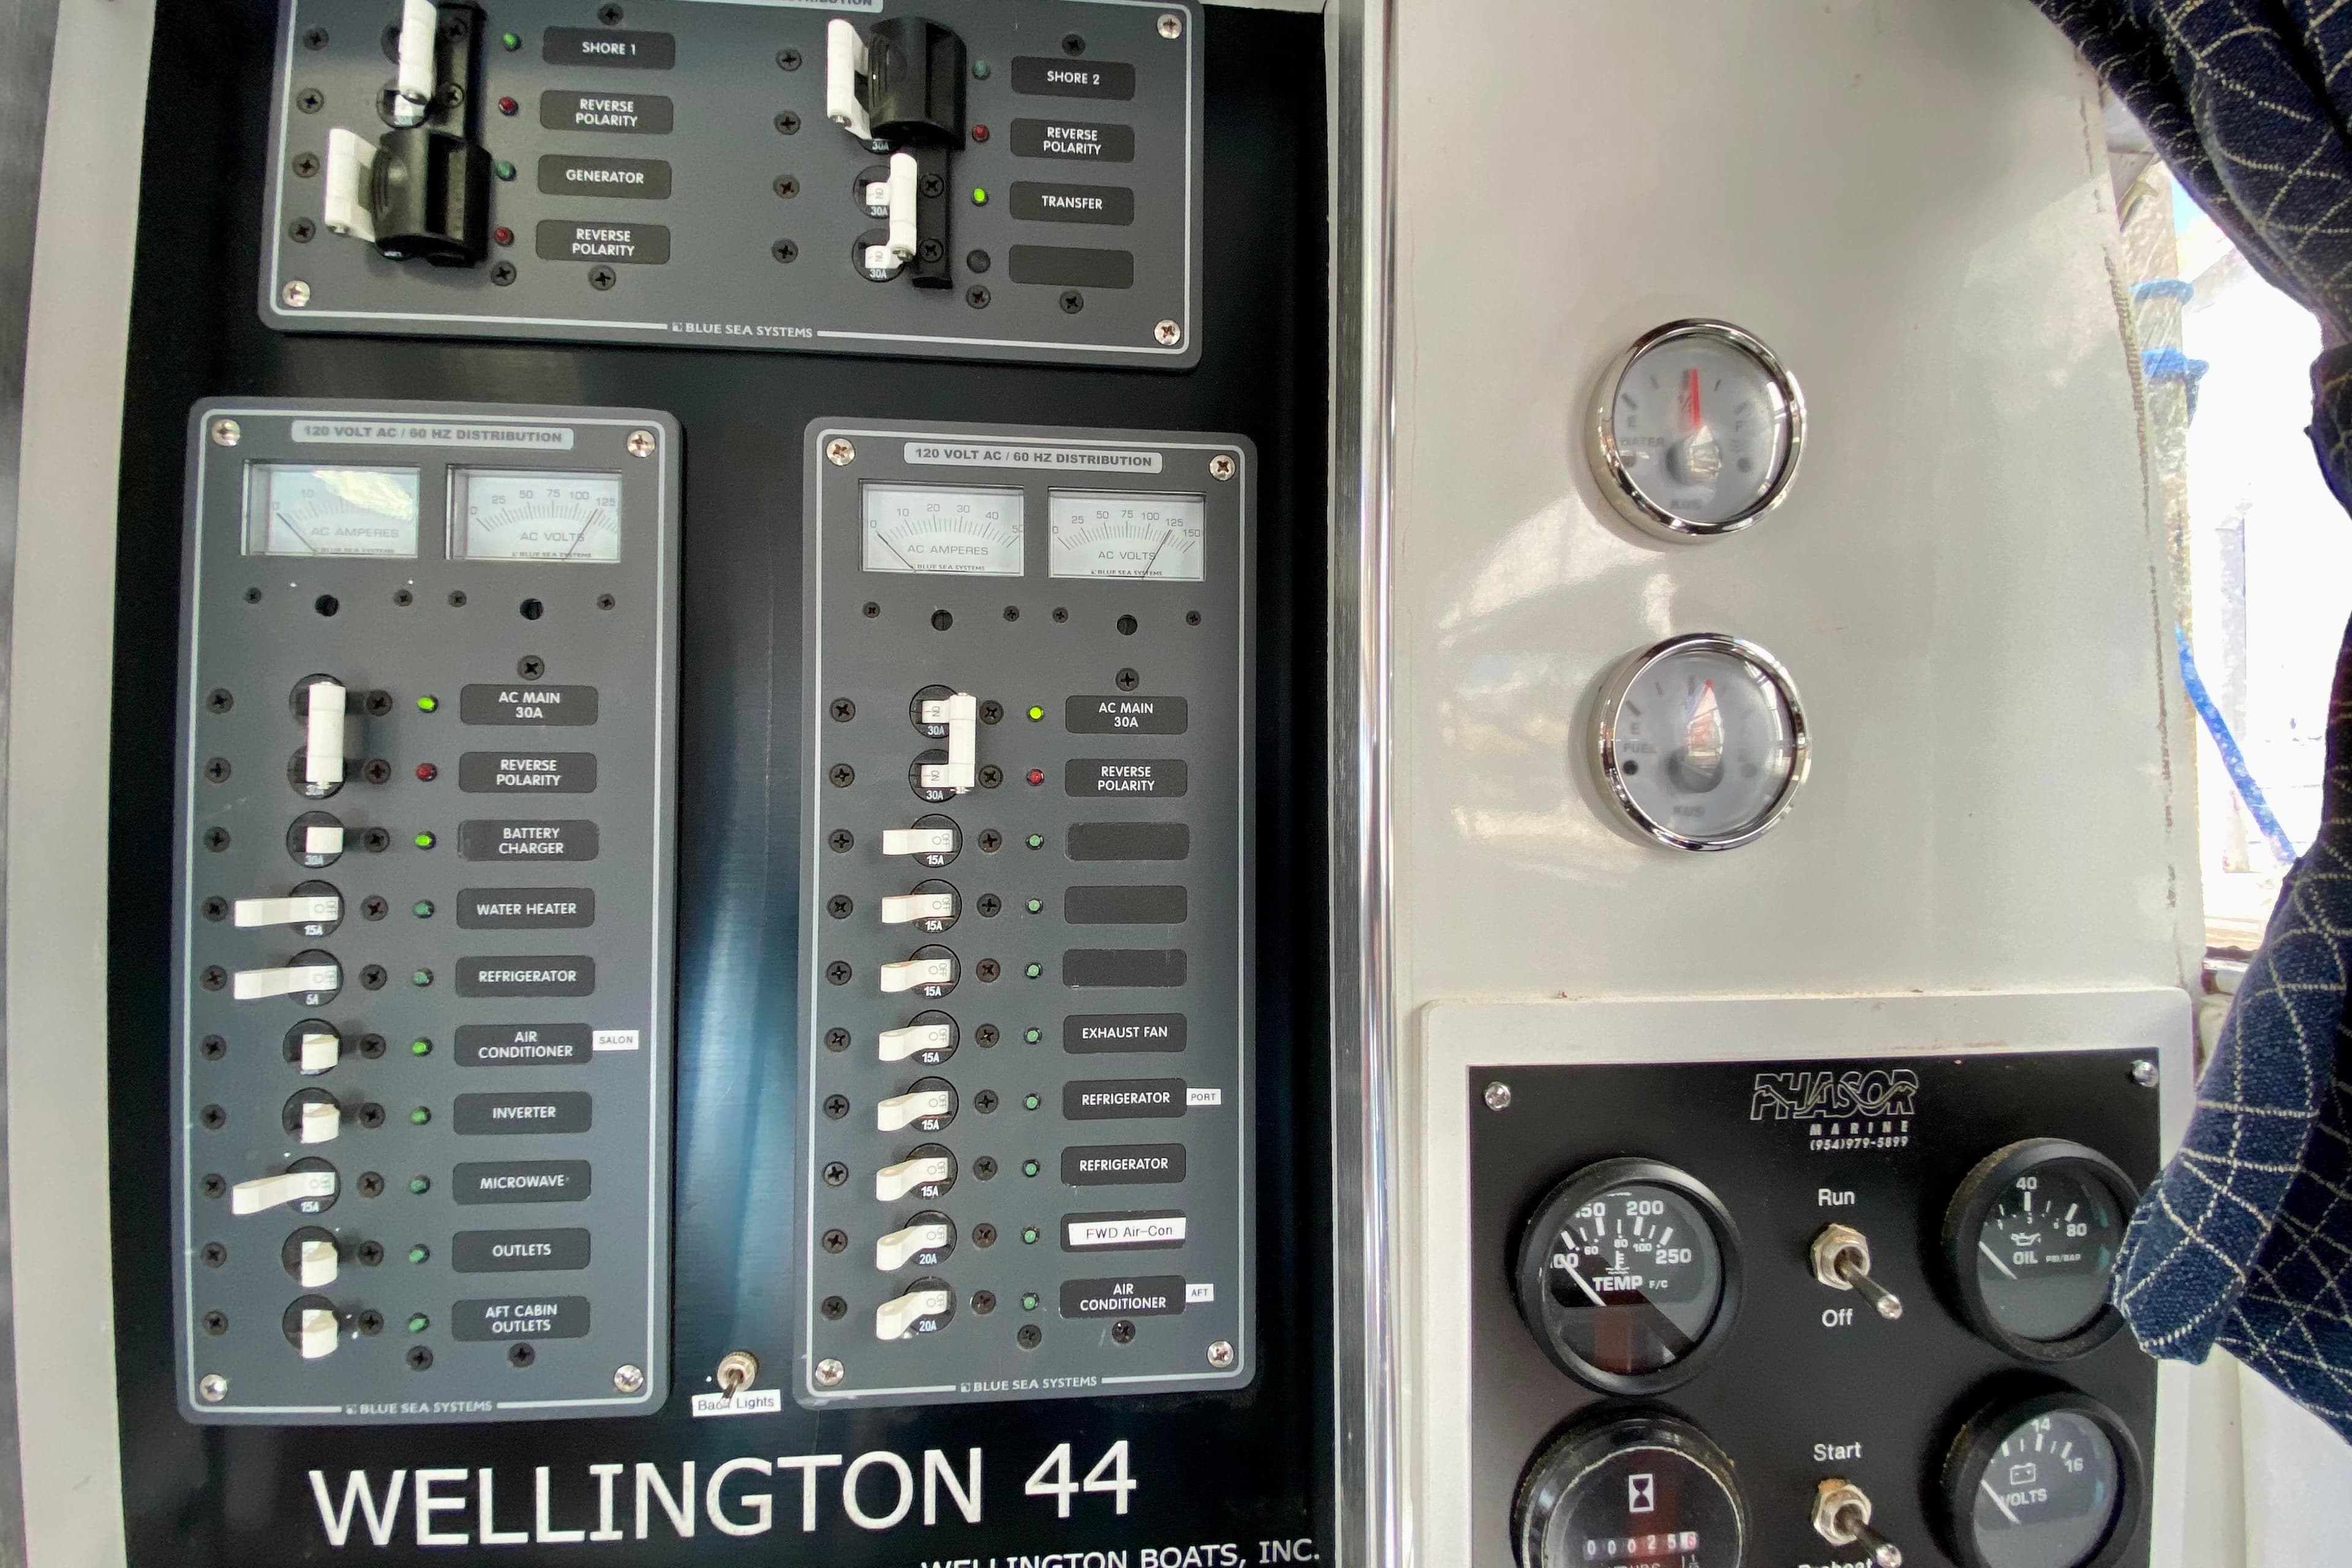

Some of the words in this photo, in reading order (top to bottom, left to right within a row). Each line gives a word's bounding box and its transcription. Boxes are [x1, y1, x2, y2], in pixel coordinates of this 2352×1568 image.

[582, 42, 625, 55] SHORE
[631, 43, 636, 55] 1
[1047, 70, 1088, 84] SHORE
[1093, 74, 1100, 85] 2
[580, 99, 633, 113] REVERSE
[576, 112, 638, 127] POLARITY
[1047, 126, 1098, 141] REVERSE
[872, 141, 889, 151] 30A
[1043, 140, 1101, 155] POLARITY
[566, 169, 644, 184] GENERATOR
[1041, 195, 1102, 210] TRANSFER
[871, 206, 888, 216] 30A
[576, 228, 631, 242] REVERSE
[572, 243, 635, 257] POLARITY
[870, 269, 887, 279] 30A
[686, 322, 722, 334] BLUE
[725, 325, 753, 336] SEA
[756, 326, 813, 338] SYSTEMS
[304, 426, 330, 436] 120
[334, 428, 372, 437] VOLT
[376, 428, 397, 438] AC
[409, 429, 426, 439] 60
[432, 428, 453, 441] HZ
[456, 430, 562, 442] DISTRIBUTION
[916, 448, 939, 458] 120
[944, 449, 979, 459] VOLT
[984, 451, 1001, 460] AC
[1014, 453, 1029, 461] 60
[1033, 451, 1052, 464] HZ
[1057, 454, 1152, 466] DISTRIBUTION
[491, 495, 506, 504] 25
[519, 490, 533, 499] 50
[548, 489, 560, 497] 75
[569, 491, 589, 500] 100
[595, 497, 615, 506] 125
[927, 503, 940, 512] 20
[1121, 510, 1133, 518] 75
[311, 527, 330, 537] AC
[334, 528, 399, 538] AMPERES
[544, 533, 584, 541] VOLTS
[930, 546, 989, 555] AMPERES
[1120, 551, 1156, 560] VOLTS
[499, 692, 519, 703] AC
[522, 692, 560, 704] MAIN
[516, 706, 543, 718] 30A
[1098, 702, 1116, 714] AC
[1120, 702, 1153, 714] MAIN
[1114, 716, 1139, 728] 30A
[927, 725, 944, 736] 30A
[500, 759, 557, 771] REVERSE
[1101, 766, 1151, 777] REVERSE
[496, 774, 561, 786] POLARITY
[1098, 780, 1155, 791] POLARITY
[926, 790, 943, 800] 30A
[503, 827, 560, 839] BATTERY
[499, 842, 564, 854] CHARGER
[926, 855, 944, 865] 15A
[477, 903, 521, 916] WATER
[526, 903, 576, 914] HEATER
[304, 925, 323, 935] 15A
[925, 920, 943, 932] 15A
[478, 970, 576, 982] REFRIGERATOR
[924, 986, 942, 997] 15A
[306, 993, 319, 1005] 5A
[514, 1031, 537, 1042] AIR
[1082, 1027, 1140, 1039] EXHAUST
[1144, 1026, 1167, 1038] FAN
[599, 1036, 633, 1044] SALON
[478, 1045, 573, 1058] CONDITIONER
[921, 1052, 940, 1063] 15A
[1082, 1091, 1170, 1106] REFRIGERATOR
[1191, 1093, 1216, 1101] PORT
[1749, 1069, 1919, 1121] PHASOR
[492, 1106, 556, 1119] INVERTER
[921, 1119, 940, 1131] 15A
[1809, 1120, 1909, 1136] MARINE
[1079, 1158, 1168, 1172] REFRIGERATOR
[480, 1174, 564, 1189] MICROWAVE
[921, 1186, 939, 1197] 15A
[1818, 1188, 1855, 1207] Run
[301, 1201, 320, 1213] 15A
[2016, 1177, 2037, 1189] 40
[2067, 1223, 2087, 1237] 80
[1087, 1227, 1118, 1239] FWD
[1123, 1225, 1172, 1237] Air-Con
[1627, 1200, 1664, 1216] 200
[1656, 1248, 1692, 1264] 250
[492, 1243, 551, 1257] OUTLETS
[1584, 1245, 1599, 1254] 60
[1633, 1243, 1651, 1252] 100
[919, 1254, 937, 1265] 20A
[2013, 1251, 2038, 1265] OIL
[1113, 1283, 1134, 1295] AIR
[1592, 1275, 1643, 1291] TEMP
[1649, 1280, 1668, 1289] F/C
[1191, 1288, 1208, 1297] AFT
[1080, 1297, 1166, 1311] CONDITIONER
[485, 1305, 510, 1318] AFT
[514, 1304, 557, 1317] CABIN
[1822, 1308, 1853, 1327] Off
[492, 1319, 551, 1333] OUTLETS
[919, 1321, 937, 1332] 20A
[973, 1380, 1010, 1393] BLUE
[1011, 1378, 1039, 1390] SEA
[1042, 1375, 1098, 1389] SYSTEMS
[359, 1402, 398, 1414] BLUE
[399, 1401, 429, 1414] SEA
[433, 1399, 492, 1413] SYSTEMS
[737, 1397, 774, 1409] Lights
[2031, 1418, 2051, 1431] 14
[2065, 1457, 2084, 1472] 16
[1814, 1442, 1861, 1461] Start
[306, 1447, 984, 1551] WELLINGTON
[1023, 1439, 1138, 1520] 44
[1140, 1543, 1246, 1568] BOATS,
[1259, 1537, 1321, 1564] INC.
